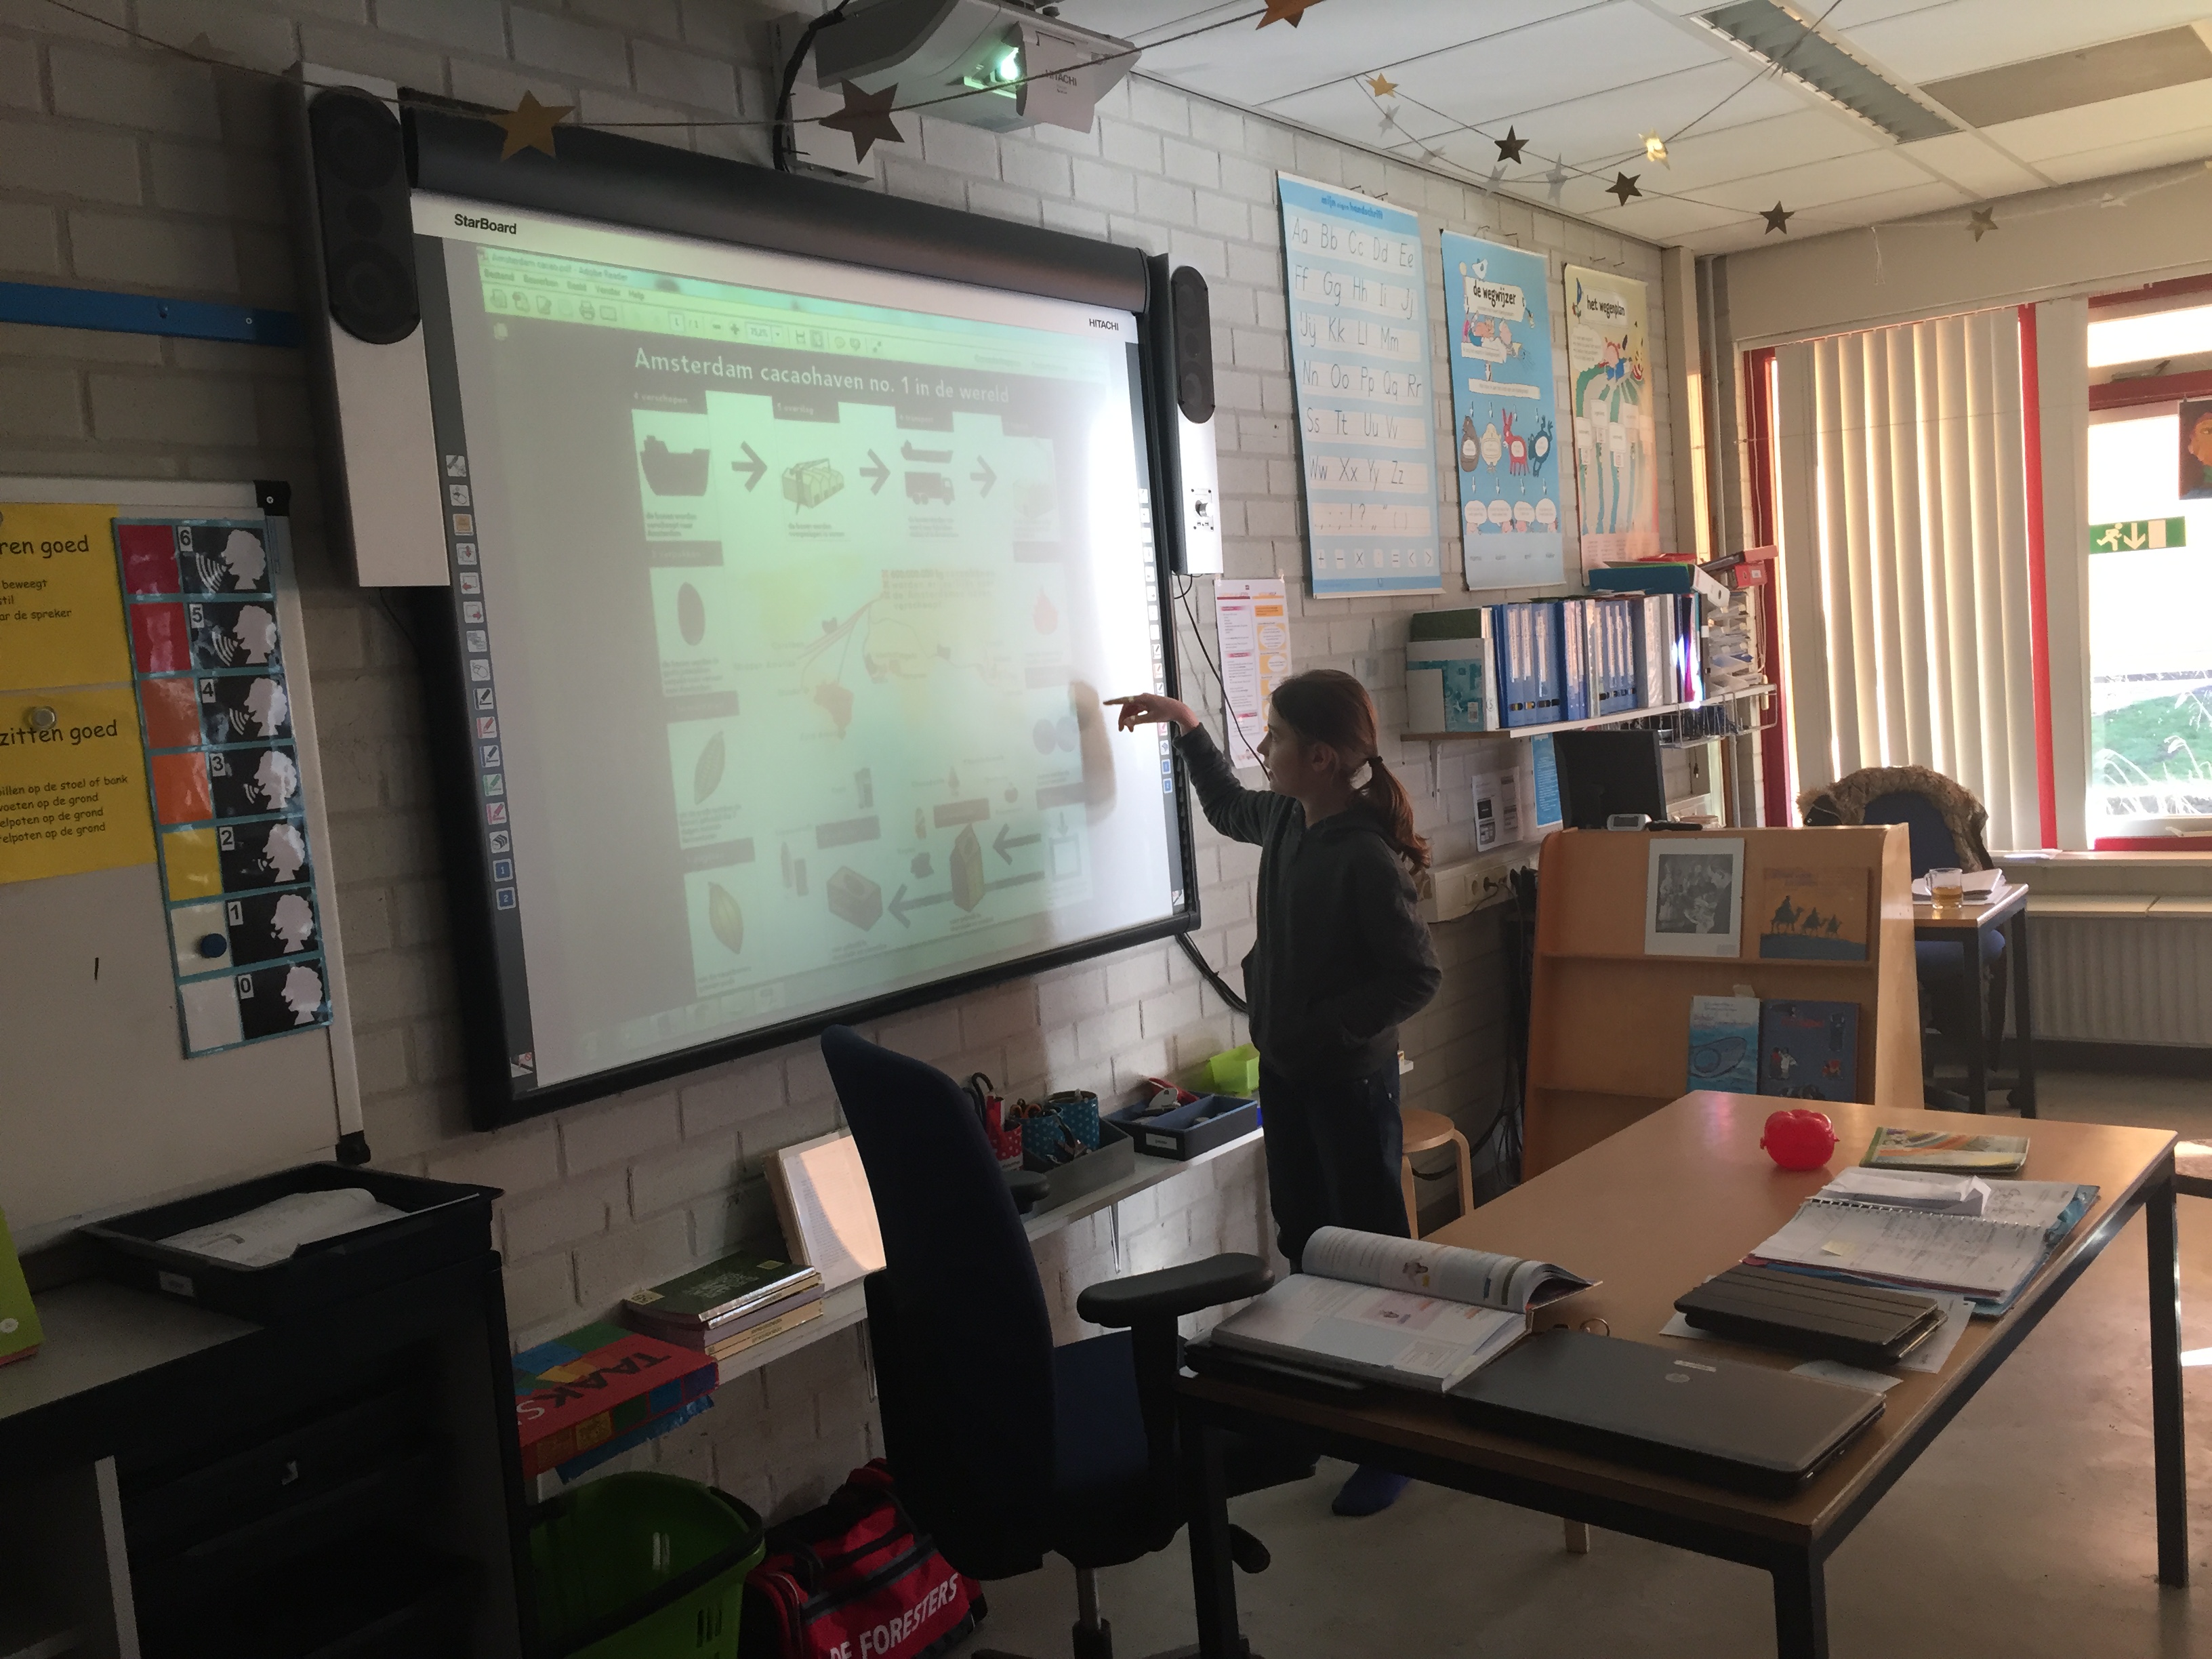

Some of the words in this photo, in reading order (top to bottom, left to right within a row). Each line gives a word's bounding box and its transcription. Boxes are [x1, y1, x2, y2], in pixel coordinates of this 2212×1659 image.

[454, 213, 516, 234] StarBoard
[1292, 218, 1308, 244] Aa
[1321, 224, 1338, 250] Bb
[1348, 230, 1364, 256] Cc
[1373, 237, 1388, 263] Dd
[1399, 243, 1414, 268] Ee
[1324, 271, 1341, 307] Gg
[1473, 280, 1481, 298] de
[1483, 287, 1517, 308] wegwijzer
[1587, 294, 1598, 310] het
[1089, 319, 1119, 331] HITACHI
[1328, 317, 1345, 343] Kk
[635, 347, 753, 380] Amsterdam
[760, 365, 863, 391] cacaohaven
[869, 378, 895, 392] no.
[901, 376, 909, 394] 1
[916, 377, 930, 396] in
[935, 380, 954, 398] de
[960, 384, 1009, 403] wereld
[1334, 409, 1348, 435] Tt
[1391, 460, 1404, 485] Zz
[0, 541, 34, 555] ren
[41, 534, 89, 558] goed
[180, 530, 191, 546] 6
[1, 579, 47, 591] beweegt
[14, 611, 28, 620] de
[30, 609, 72, 621] spreker
[192, 608, 203, 623] 5
[203, 682, 214, 697] 4
[0, 727, 64, 746] zitten
[70, 718, 117, 745] goed
[212, 756, 224, 771] 3
[28, 785, 41, 796] op
[43, 782, 58, 792] de
[60, 778, 86, 791] stoel
[89, 777, 101, 787] of
[103, 775, 128, 785] bank
[0, 801, 34, 813] voeten
[37, 800, 49, 810] op
[53, 796, 66, 806] de
[68, 792, 99, 807] grond
[0, 817, 39, 830] elpoten
[43, 815, 55, 825] op
[58, 811, 71, 821] de
[74, 807, 104, 822] grond
[0, 832, 42, 844] elpoten
[45, 830, 58, 840] op
[60, 826, 73, 836] de
[76, 822, 106, 837] grond
[221, 830, 233, 846] 2
[230, 904, 239, 920] 1
[240, 977, 251, 994] 0
[859, 1572, 960, 1659] FORESTERS
